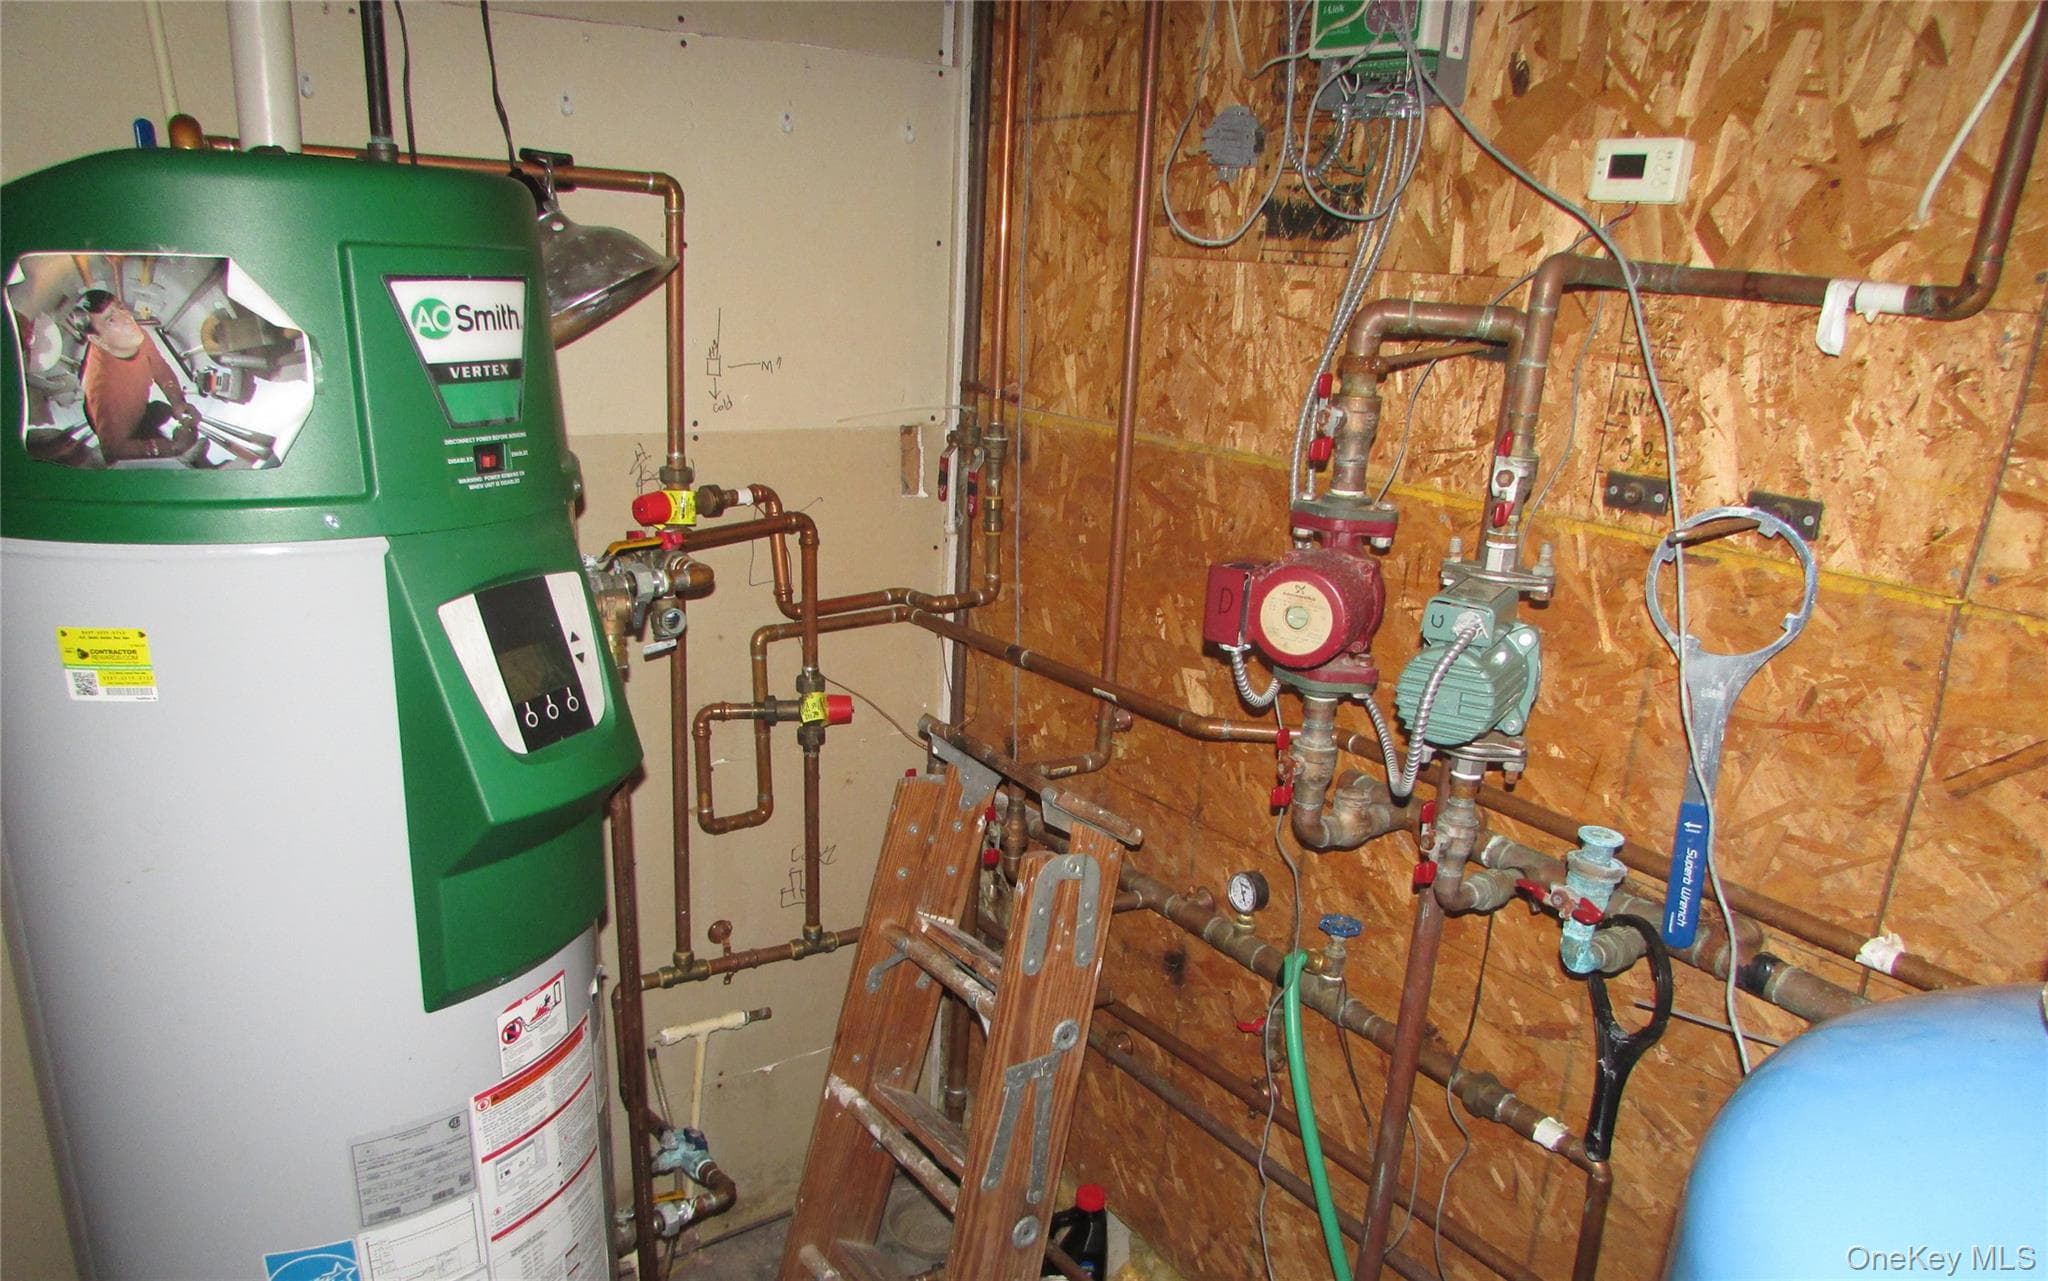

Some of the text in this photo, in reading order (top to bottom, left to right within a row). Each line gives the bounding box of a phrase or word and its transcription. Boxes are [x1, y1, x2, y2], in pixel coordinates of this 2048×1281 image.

[414, 303, 521, 335] AO Smith
[449, 363, 510, 379] VERTEX
[447, 456, 474, 465] DISABLED
[1218, 587, 1234, 614] D
[1676, 847, 1698, 928] Superb Wrench
